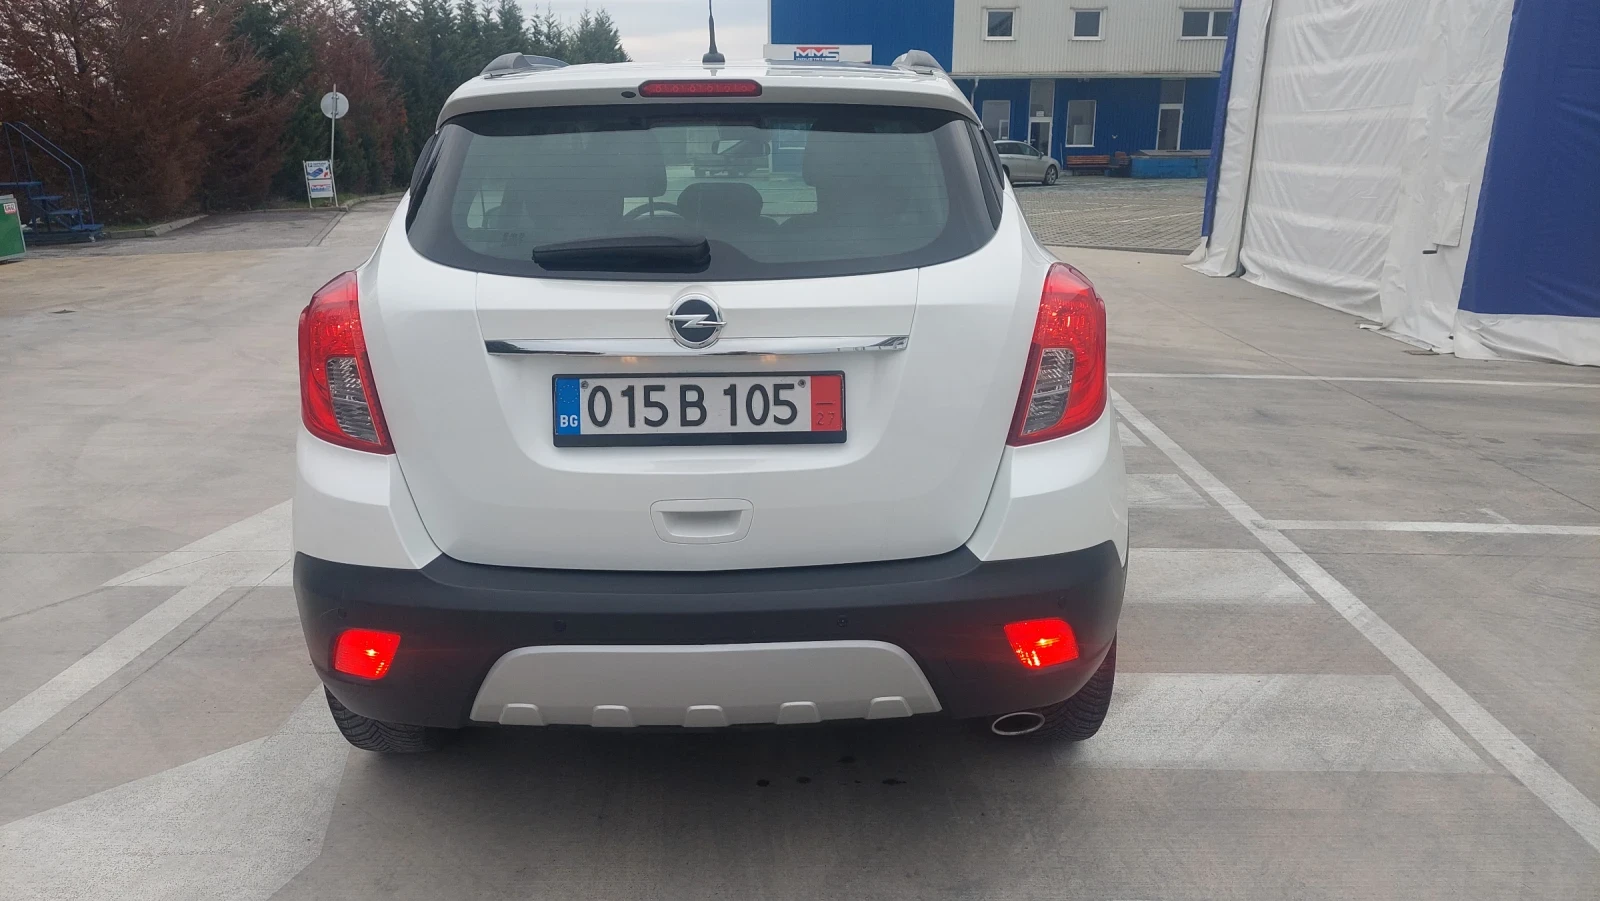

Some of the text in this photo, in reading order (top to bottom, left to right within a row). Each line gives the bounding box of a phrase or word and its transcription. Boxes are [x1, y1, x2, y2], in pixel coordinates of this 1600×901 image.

[794, 47, 839, 61] MMS
[587, 383, 798, 428] 015 B 105
[560, 414, 579, 428] BG
[816, 411, 836, 426] 27
